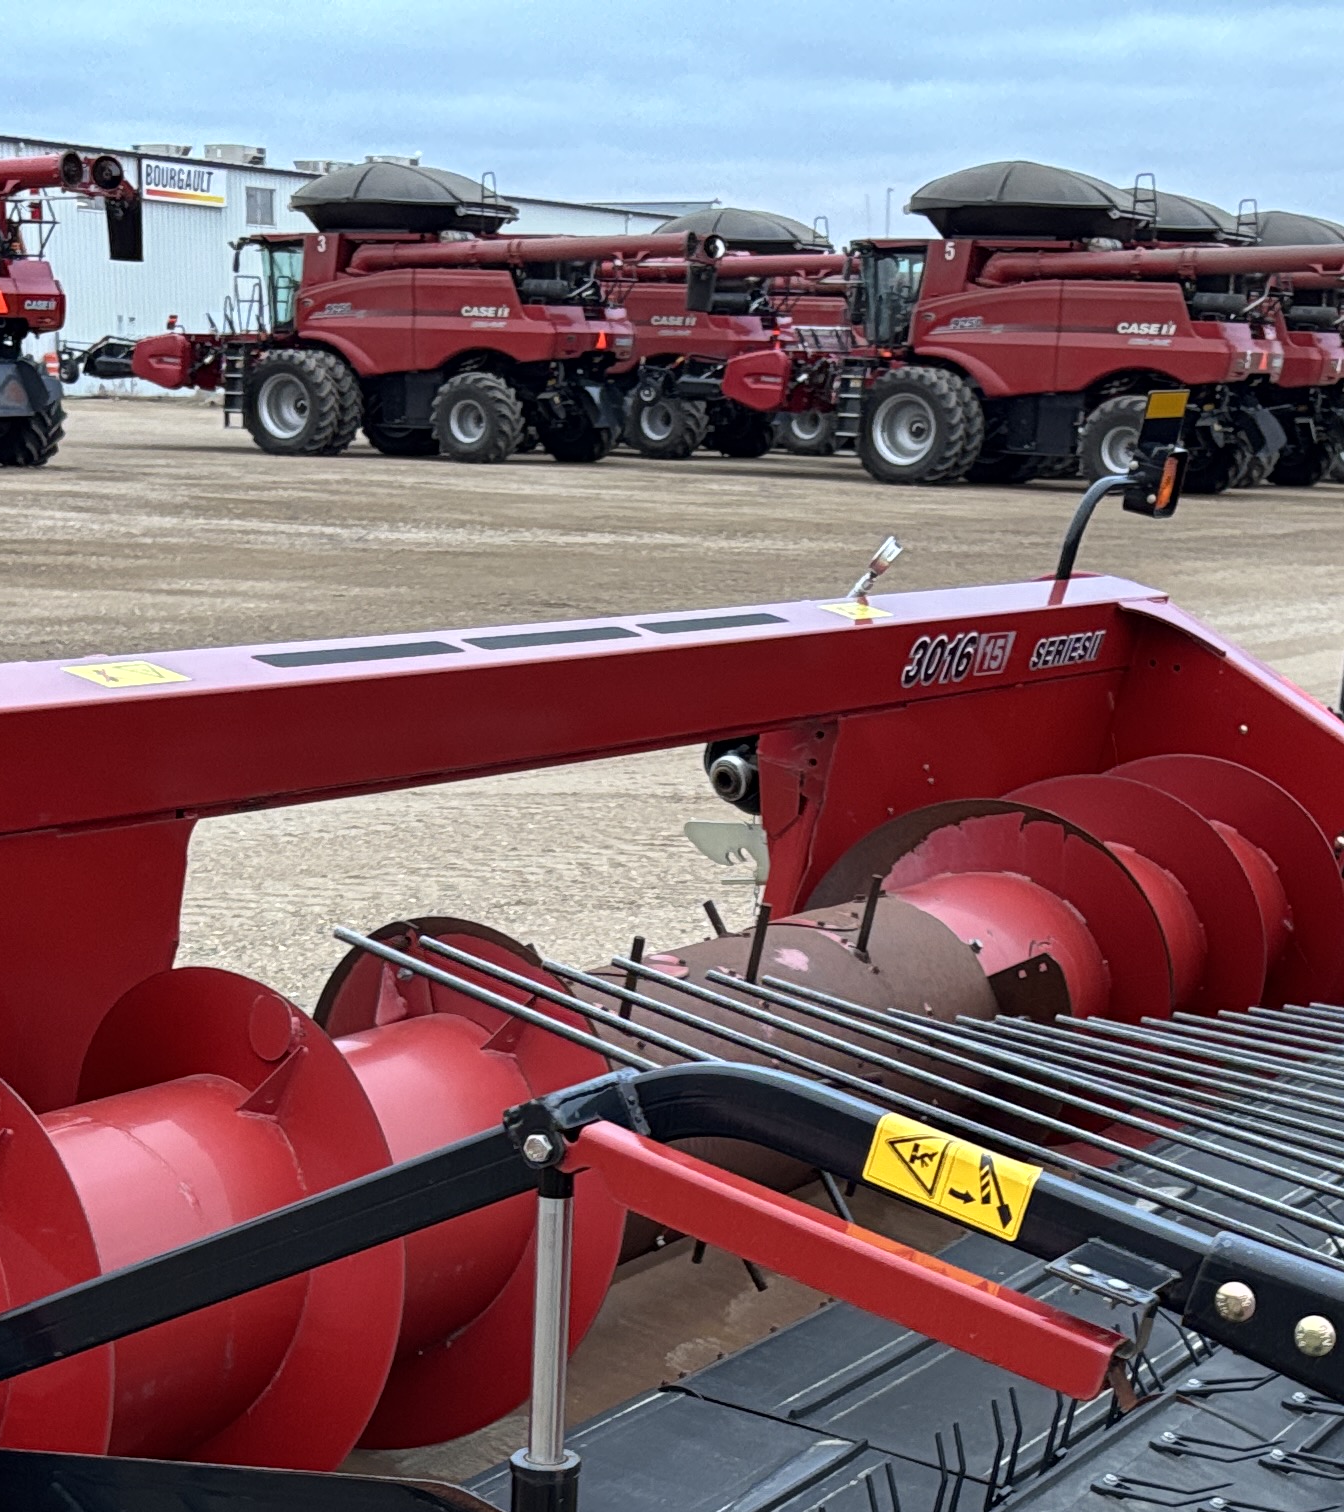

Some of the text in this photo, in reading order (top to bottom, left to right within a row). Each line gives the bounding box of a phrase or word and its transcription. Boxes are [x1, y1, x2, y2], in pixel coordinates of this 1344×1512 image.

[145, 163, 214, 193] BOURGAULT
[316, 235, 327, 252] 3
[944, 242, 955, 260] 5
[461, 306, 496, 318] CASE
[651, 316, 683, 326] CASE
[1117, 322, 1161, 335] CASE
[901, 630, 979, 689] 3016
[981, 636, 1007, 671] 15
